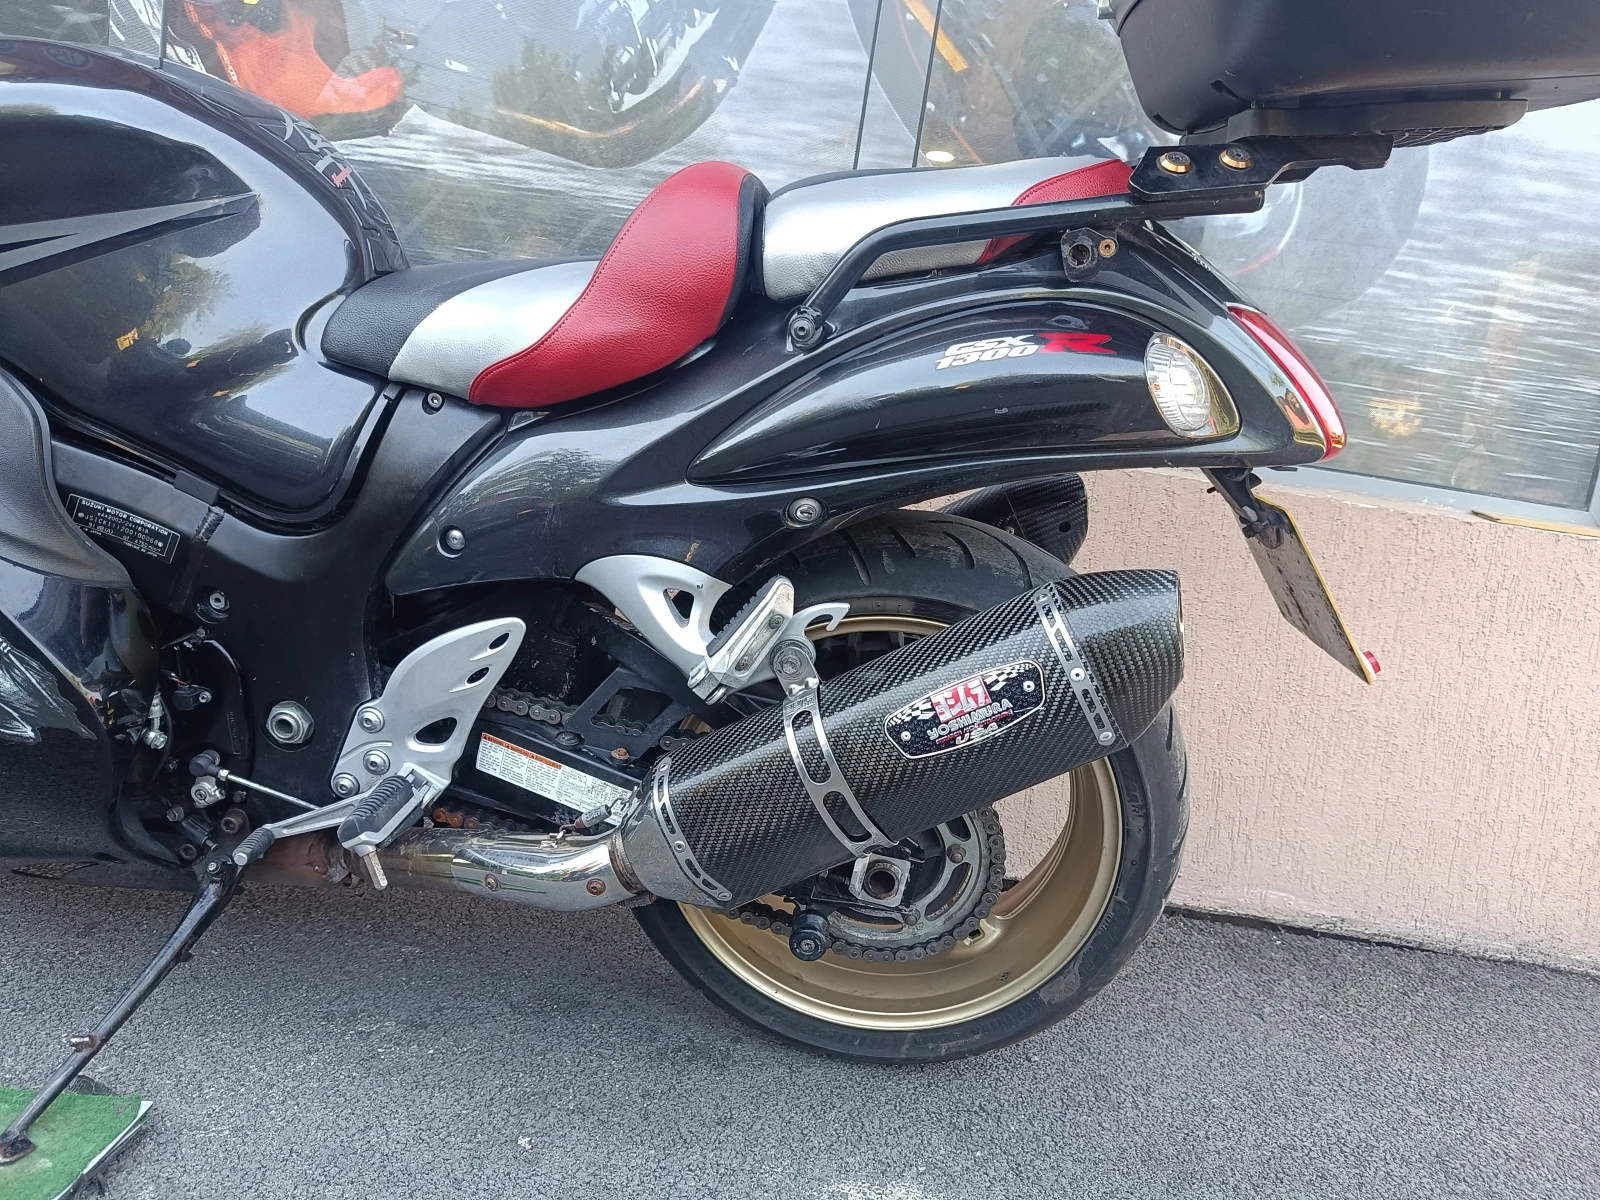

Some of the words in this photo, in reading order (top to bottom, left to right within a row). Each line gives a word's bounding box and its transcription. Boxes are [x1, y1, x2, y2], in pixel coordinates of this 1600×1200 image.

[1036, 332, 1118, 355] R
[934, 344, 1040, 371] 1300
[81, 499, 105, 511] SUZUKI
[106, 507, 128, 519] MOTOR
[129, 516, 169, 536] CORPORATION
[926, 698, 1014, 741] YOSHIMURA
[956, 722, 998, 745] USA
